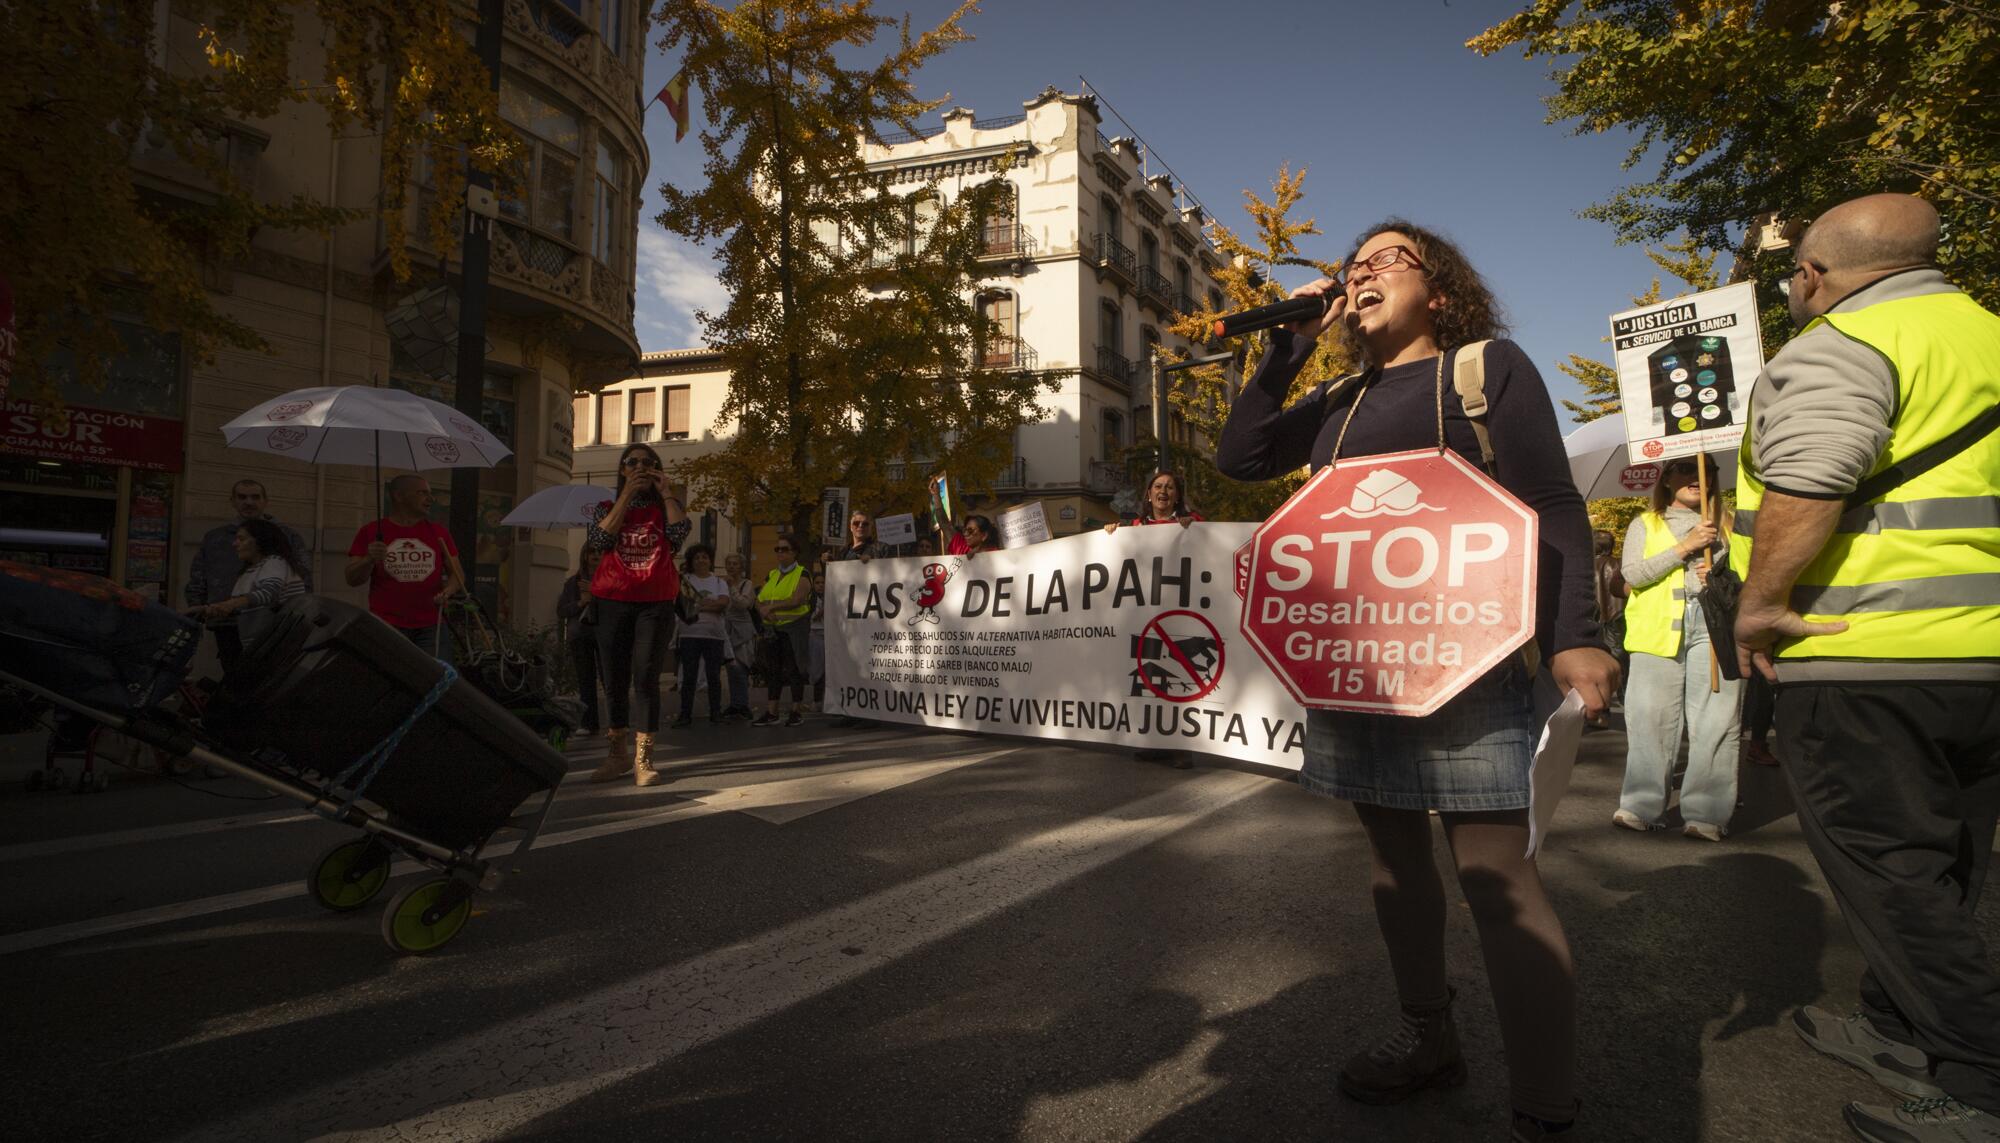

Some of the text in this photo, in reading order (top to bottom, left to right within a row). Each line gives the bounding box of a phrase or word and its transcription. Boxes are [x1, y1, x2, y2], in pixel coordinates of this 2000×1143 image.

[1619, 305, 1693, 332] LA JUSTICIA
[1621, 315, 1734, 349] AL SERVICIO DE LA BANCA
[8, 415, 104, 444] SUR
[386, 551, 432, 563] STOP
[1265, 522, 1510, 592] STOP
[847, 582, 904, 619] LAS
[960, 576, 1014, 618] DE
[1025, 569, 1069, 616] LA
[1082, 556, 1212, 610] PAH:
[1261, 594, 1503, 625] Desahucios
[887, 631, 893, 641] A
[894, 631, 907, 641] LOS
[908, 631, 958, 641] DESAHUCIOS
[959, 631, 974, 641] SIN
[976, 630, 1040, 642] ALTERNATIVA
[1042, 626, 1117, 640] HABITACIONAL
[1284, 630, 1463, 666] Granada
[894, 645, 904, 654] AL
[905, 645, 932, 655] PRECIO
[933, 645, 944, 655] DE
[945, 645, 960, 656] LOS
[961, 645, 1017, 657] ALQUILERES
[870, 671, 1000, 688] PARQUE PUBLICO DE VIVIENDAS
[914, 659, 924, 669] DE
[926, 659, 936, 670] LA
[936, 660, 962, 671] SAREB
[964, 660, 999, 673] (BANCO
[1001, 661, 1032, 675] MALO)
[1327, 667, 1405, 697] 15 M
[840, 686, 1307, 754] ¡POR UNA LEY DE VIVIENDA JUSTA YA
